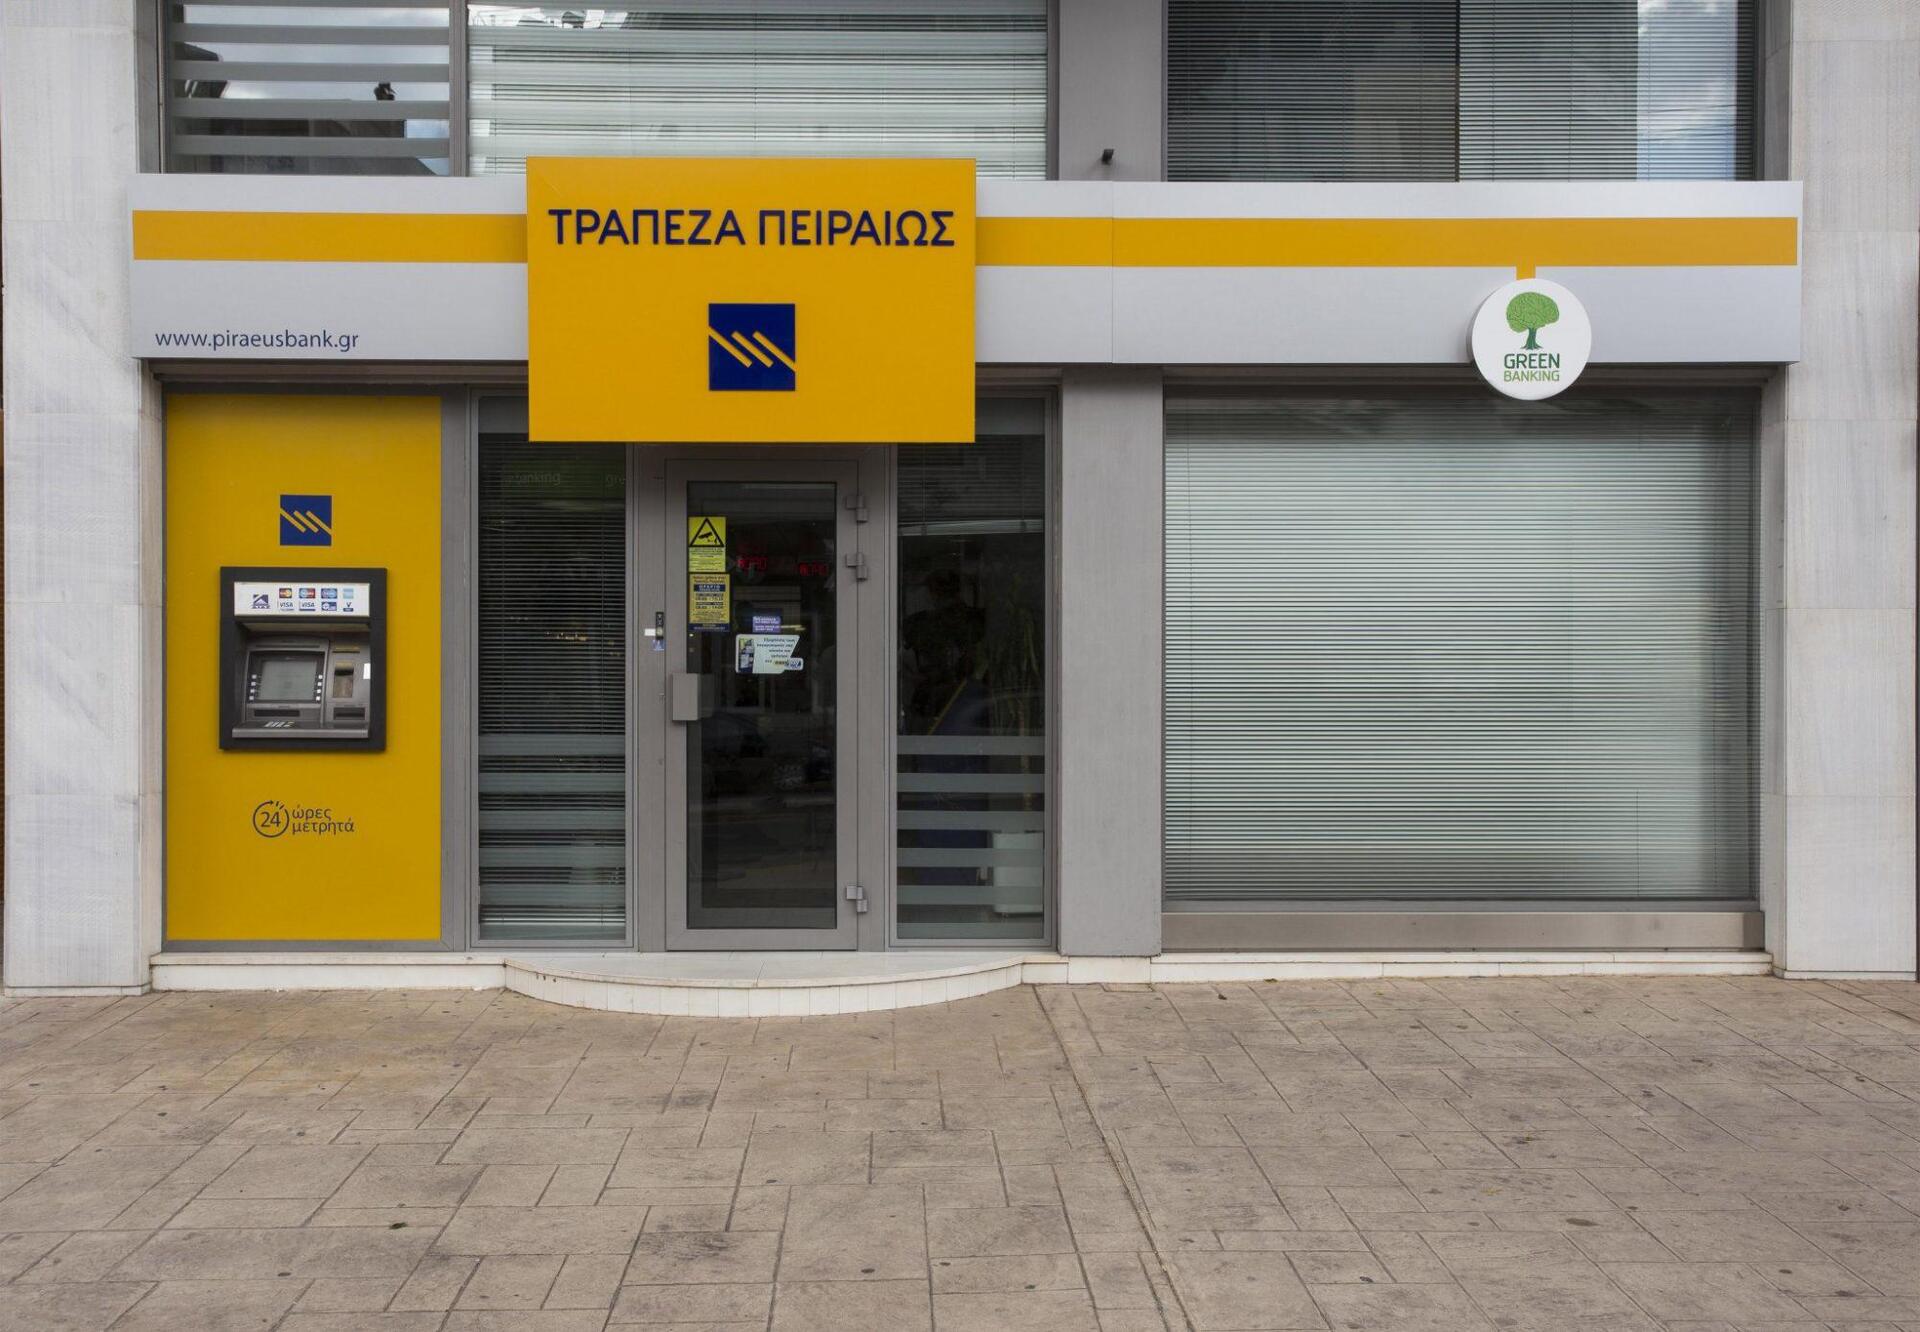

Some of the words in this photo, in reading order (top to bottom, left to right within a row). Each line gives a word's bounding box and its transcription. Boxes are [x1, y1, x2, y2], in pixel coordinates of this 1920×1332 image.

[548, 208, 745, 246] ΤΡΑΠΕΖΑ
[758, 209, 955, 247] ΠΕΙΡΑΙΩΣ
[155, 329, 358, 352] www.piraeusbank.gr
[1503, 352, 1561, 370] GREEN
[1503, 371, 1560, 383] BANKING
[260, 810, 282, 828] 24
[291, 804, 332, 821] ώρες
[292, 817, 355, 836] μετρητά
